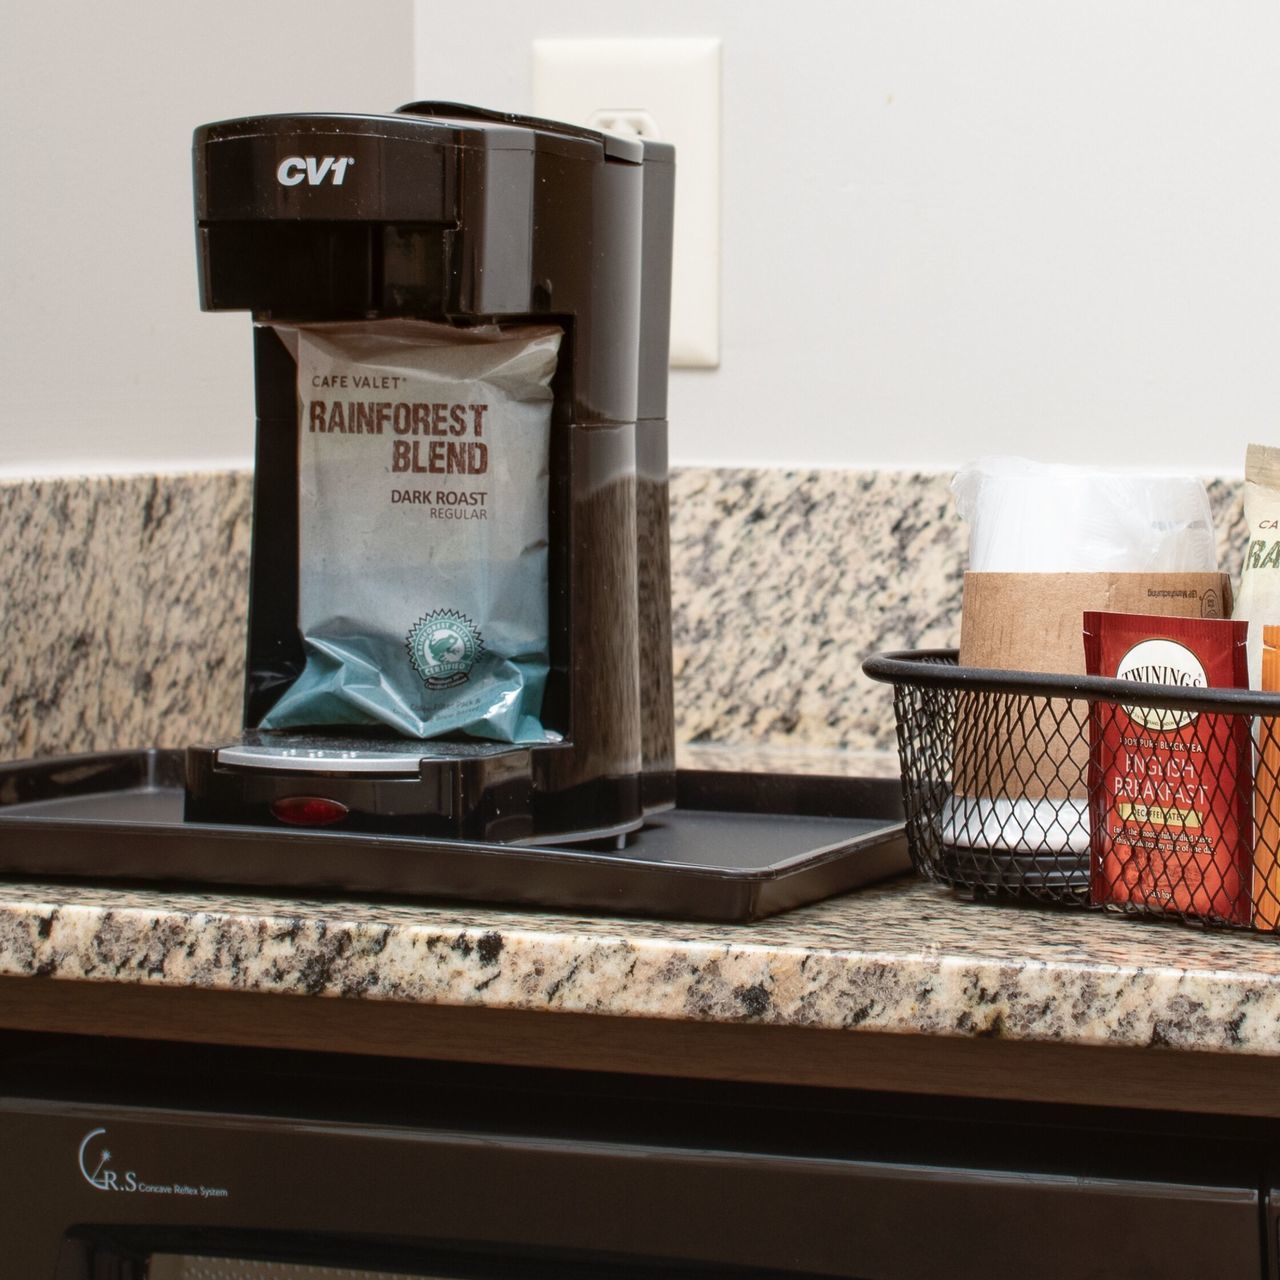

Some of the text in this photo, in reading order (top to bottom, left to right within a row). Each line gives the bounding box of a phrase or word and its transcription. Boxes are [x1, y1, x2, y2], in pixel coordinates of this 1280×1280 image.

[311, 375, 400, 389] CAFE VALET
[308, 400, 488, 437] RAINFOREST
[391, 439, 488, 475] BLEND
[391, 489, 488, 506] DARK ROAST
[430, 507, 488, 520] REGULAR
[1126, 753, 1195, 778] ENGLISH
[138, 1183, 172, 1194] Concave
[174, 1184, 198, 1195] Reflex
[200, 1186, 228, 1198] System
